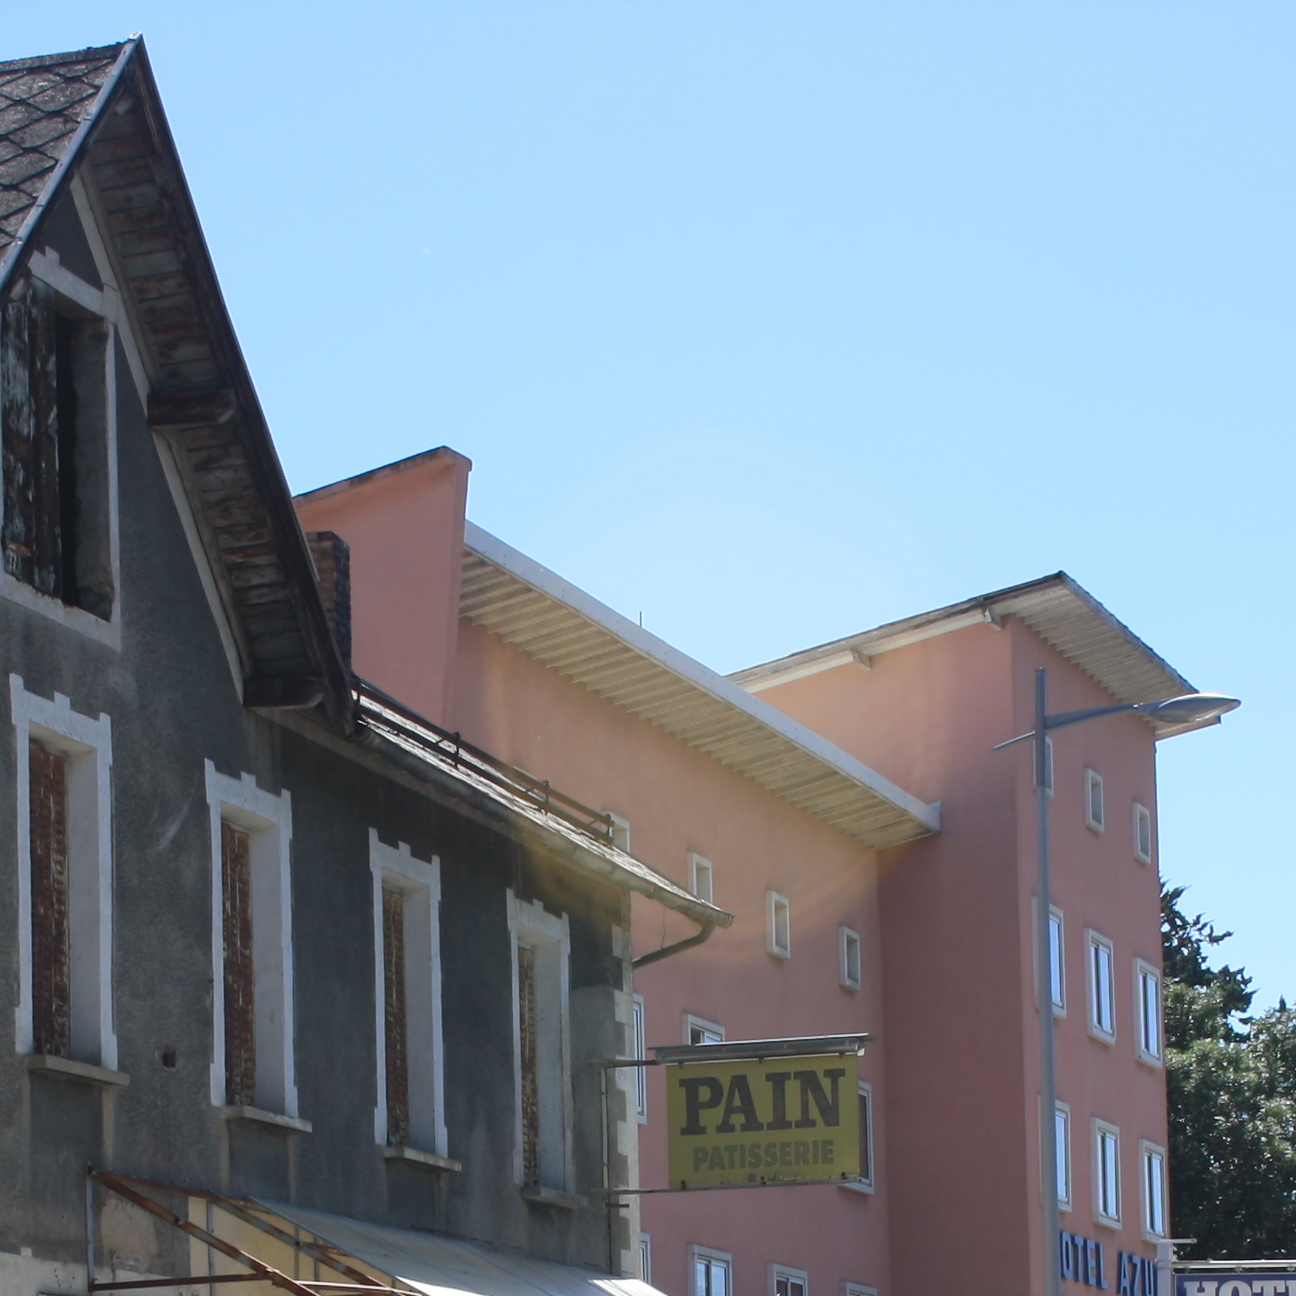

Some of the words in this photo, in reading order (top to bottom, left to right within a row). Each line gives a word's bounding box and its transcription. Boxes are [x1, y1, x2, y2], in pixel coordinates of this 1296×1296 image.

[678, 1067, 846, 1136] PAIN
[692, 1139, 834, 1172] PATISSERIE
[1060, 1230, 1109, 1290] OTEL
